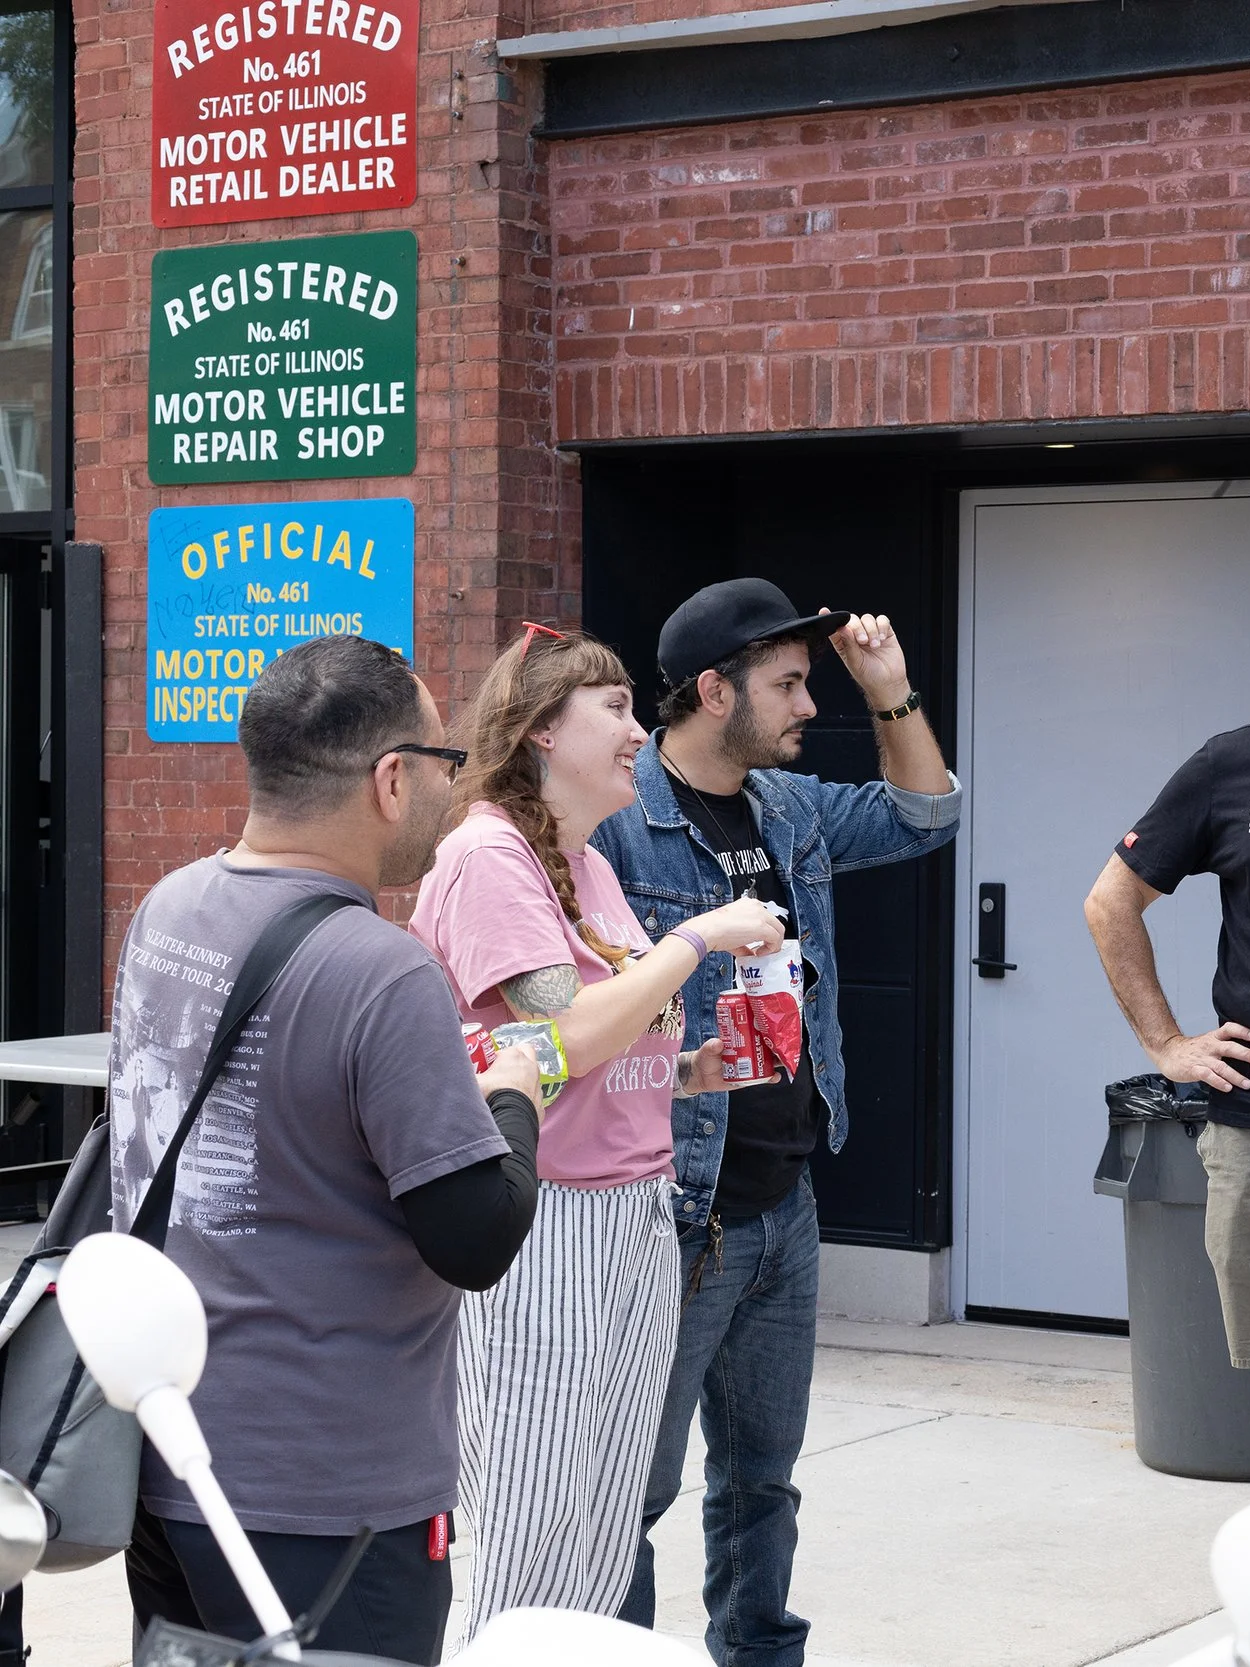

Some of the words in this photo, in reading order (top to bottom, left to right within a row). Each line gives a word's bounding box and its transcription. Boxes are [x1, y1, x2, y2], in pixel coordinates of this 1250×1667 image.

[167, 0, 402, 79] REGISTERED
[243, 57, 279, 83] No.
[283, 50, 321, 79] 461
[198, 93, 254, 120] STATE
[258, 89, 283, 113] OF
[289, 81, 367, 110] ILLINOIS
[160, 128, 268, 168] MOTOR
[280, 113, 407, 156] VEHICLE
[170, 168, 268, 208] RETAIL
[279, 156, 396, 198] DEALER
[163, 262, 399, 337] REGISTERED
[247, 321, 276, 343] No.
[279, 318, 310, 341] 461
[194, 354, 250, 379] STATE
[255, 352, 280, 376] OF
[285, 347, 364, 374] ILLINOIS
[154, 389, 266, 425] MOTOR
[277, 382, 405, 419] VEHICLE
[173, 429, 278, 464] REPAIR
[297, 424, 385, 459] SHOP
[181, 521, 376, 580] OFFICIAL
[247, 582, 275, 603] No.
[278, 581, 309, 602] 461
[194, 615, 249, 637] STATE
[254, 614, 279, 637] OF
[285, 612, 363, 638] ILLINOIS
[155, 650, 265, 680] MOTOR
[154, 687, 249, 722] INSPECT
[144, 927, 233, 970] SLEATER-KINNEY
[149, 955, 180, 977] ROPE
[181, 964, 214, 988] TOUR
[213, 977, 235, 996] 20
[755, 1045, 765, 1077] RECYCLE
[212, 1184, 246, 1195] SEATTLE,
[244, 1203, 257, 1212] WA
[201, 1227, 243, 1238] PORTLAND,
[244, 1227, 257, 1235] OR
